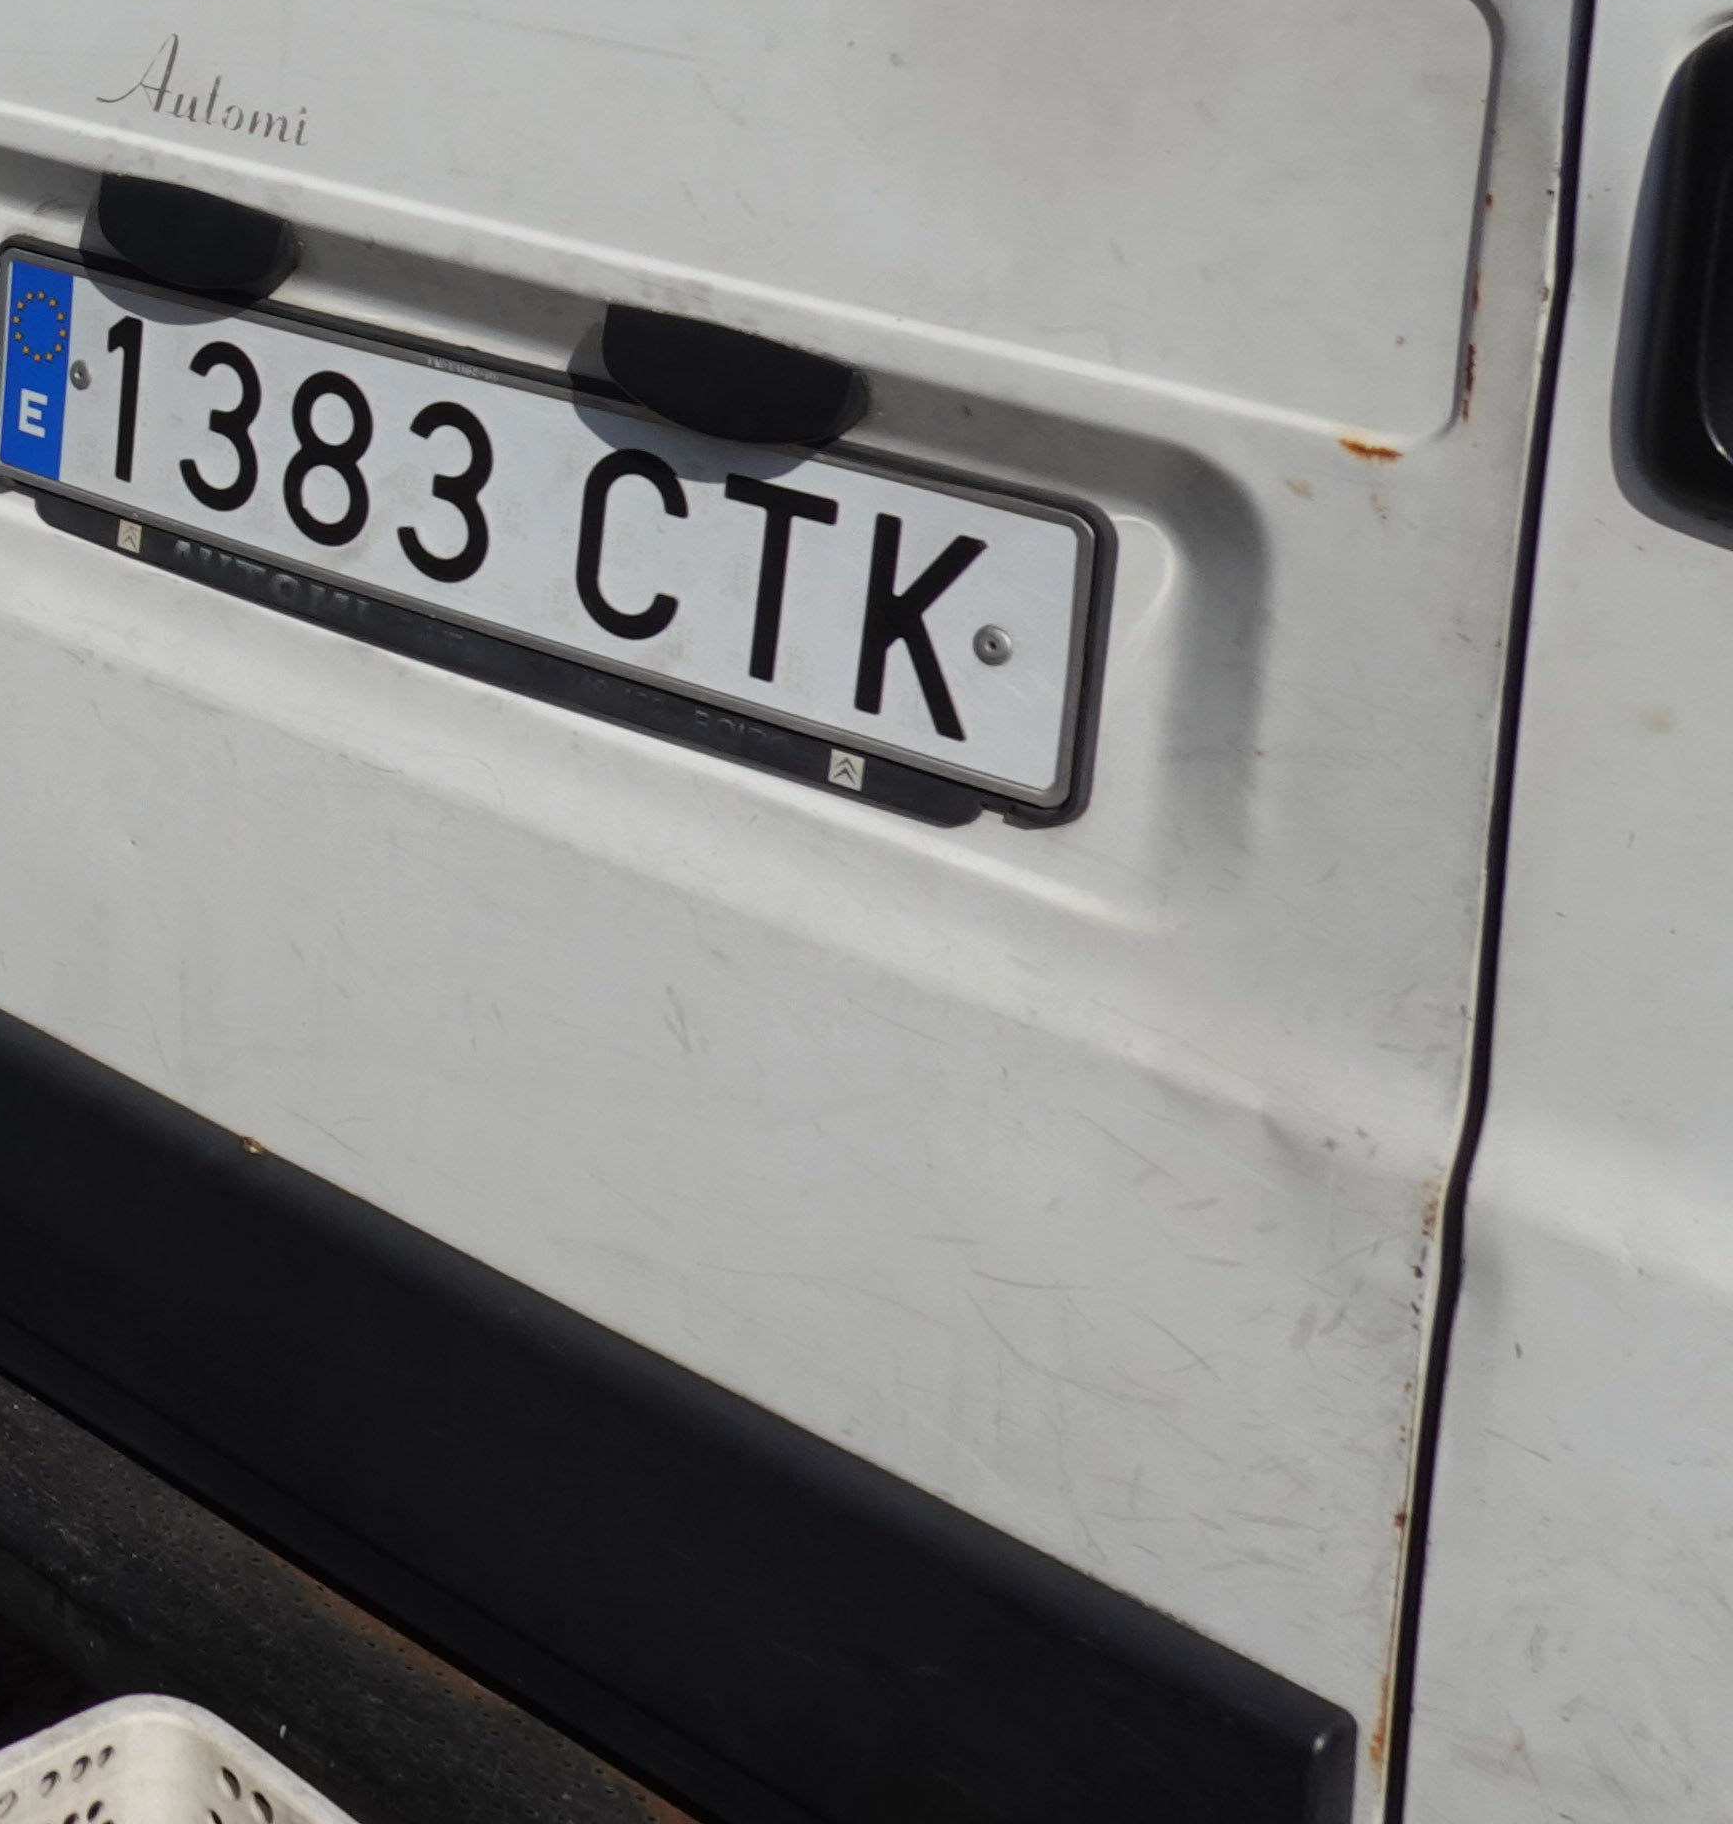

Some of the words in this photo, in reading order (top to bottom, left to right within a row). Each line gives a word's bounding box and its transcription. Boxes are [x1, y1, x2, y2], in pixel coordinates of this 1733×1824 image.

[18, 387, 49, 439] E
[107, 314, 495, 586] 1383
[573, 446, 987, 743] CTK
